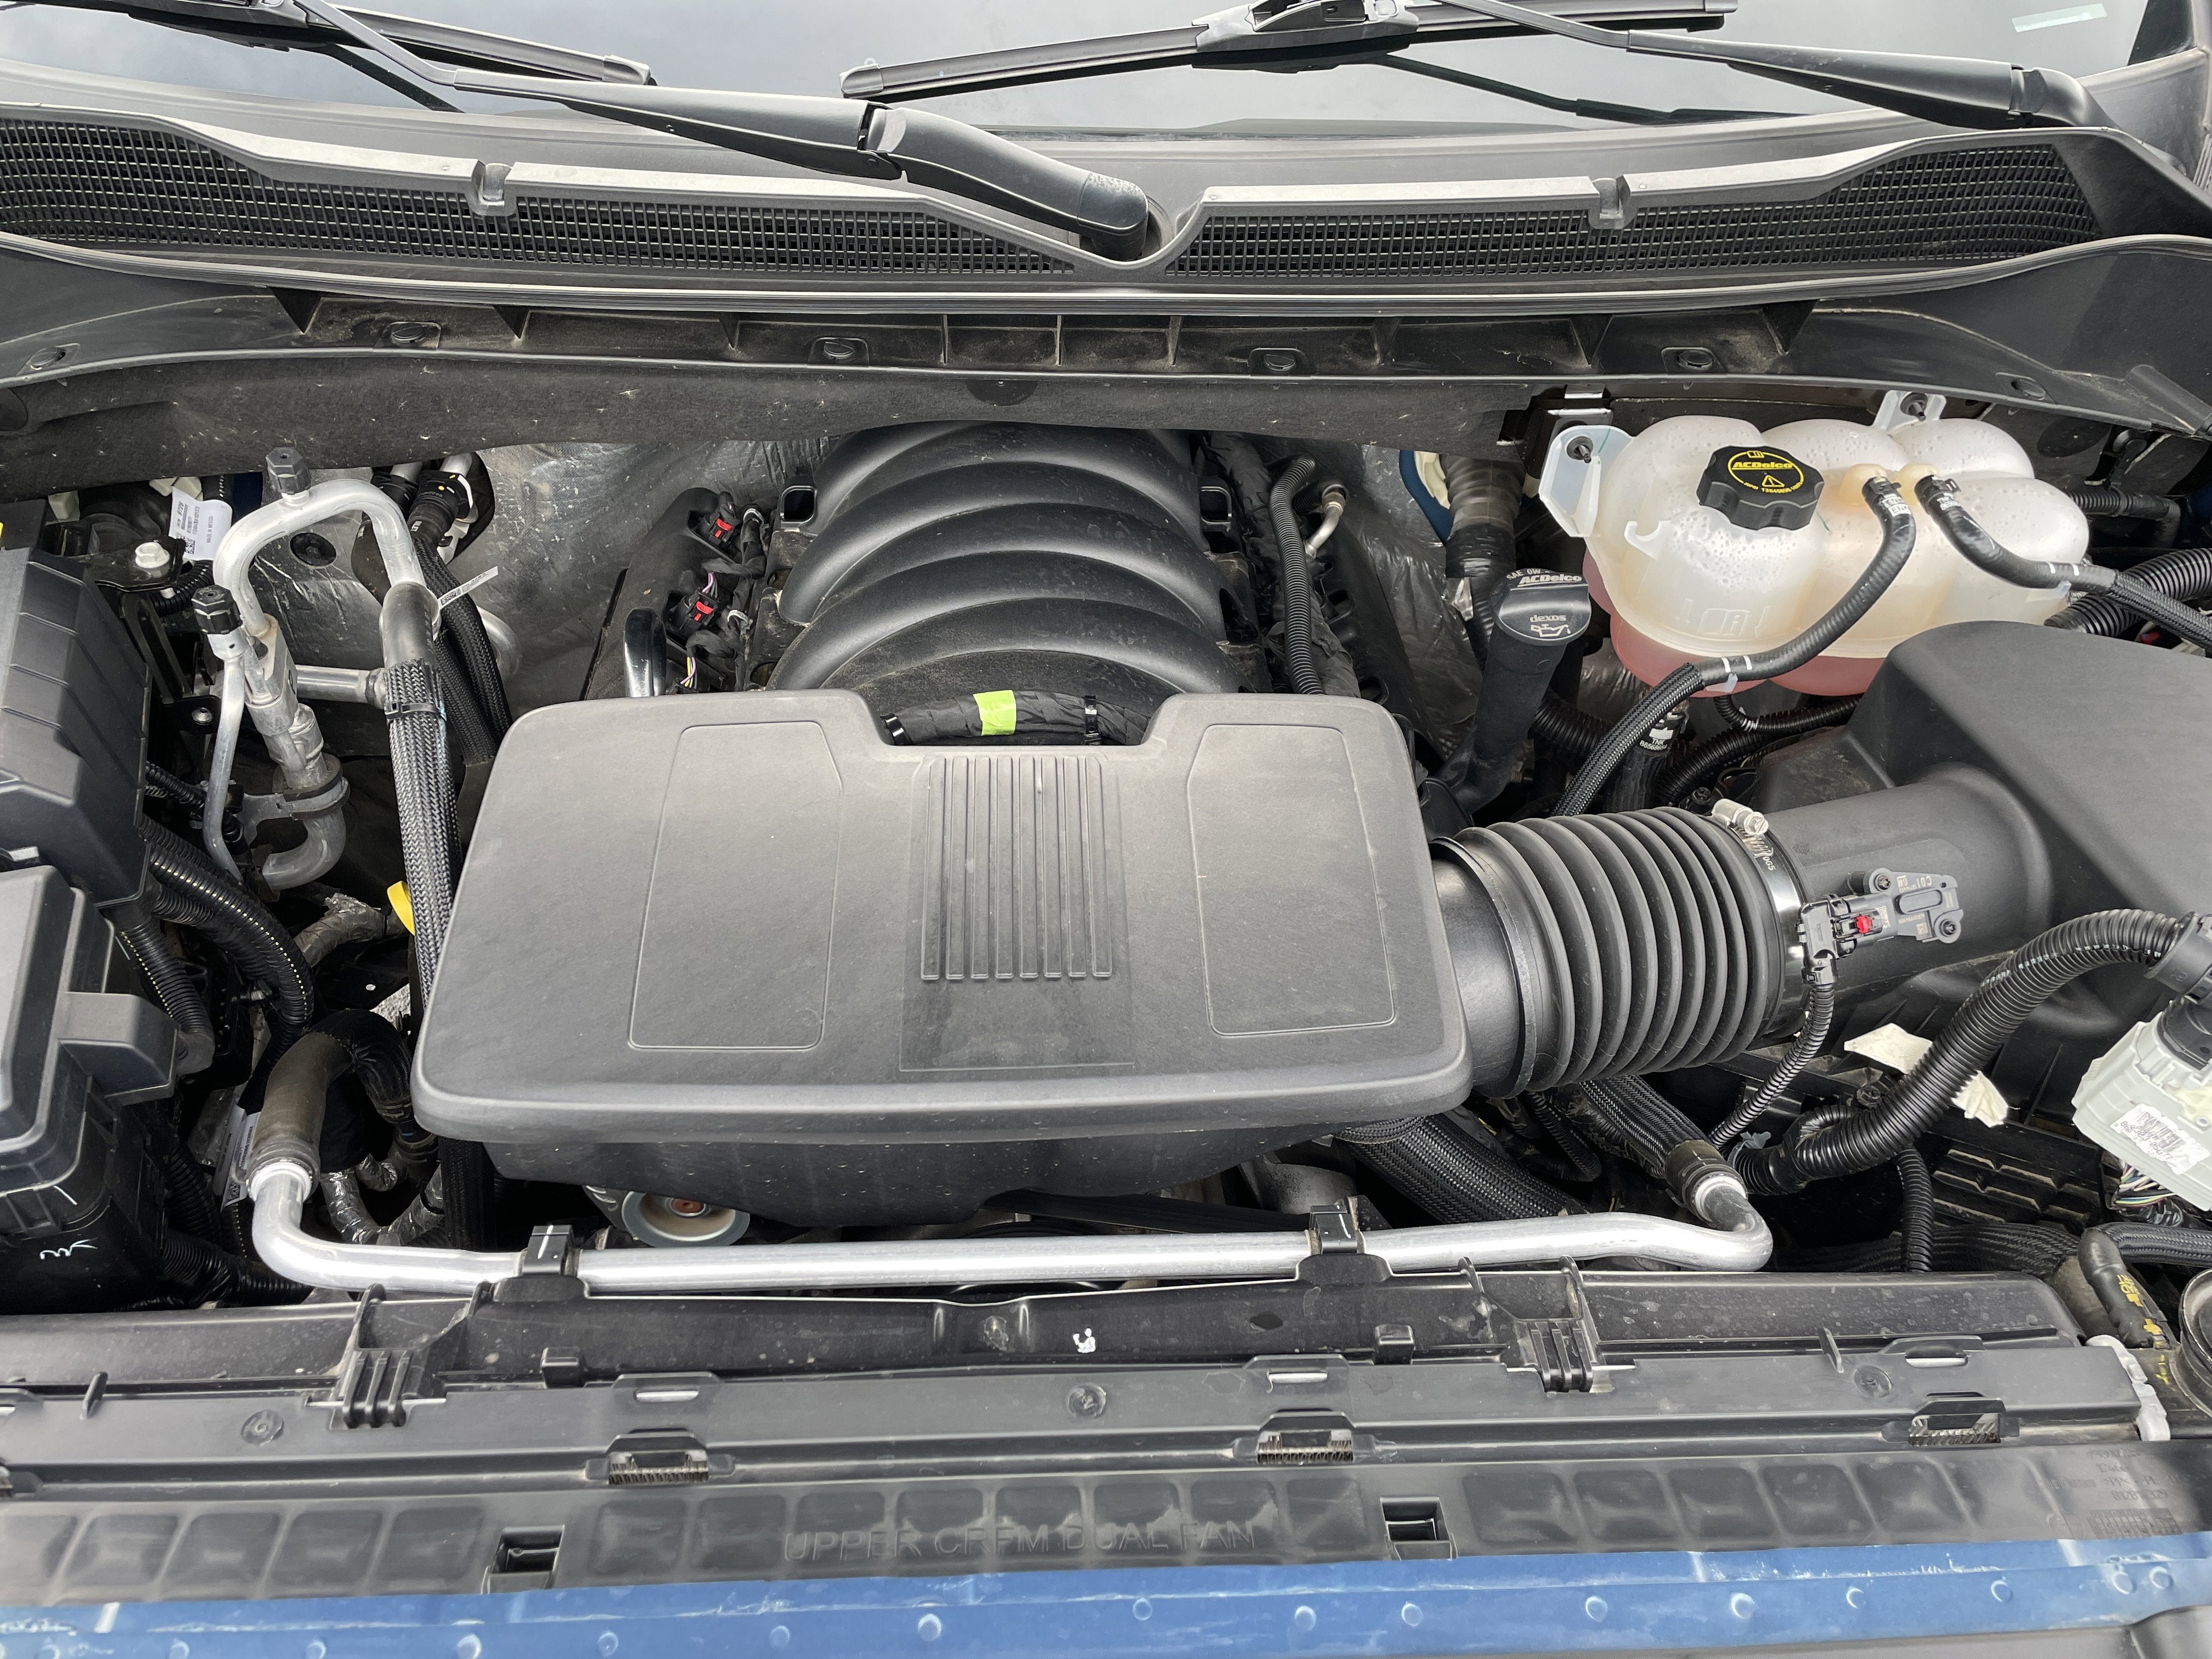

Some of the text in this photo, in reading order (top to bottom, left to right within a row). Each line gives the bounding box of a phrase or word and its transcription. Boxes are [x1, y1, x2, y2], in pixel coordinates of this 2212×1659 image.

[1506, 571, 1524, 580] SAE
[1519, 573, 1582, 585] ACDelco
[1530, 614, 1566, 623] dexos
[1897, 877, 1909, 888] GM
[782, 1527, 922, 1561] UPPER
[1064, 1522, 1169, 1552] DUAL
[1182, 1520, 1255, 1549] FAN
